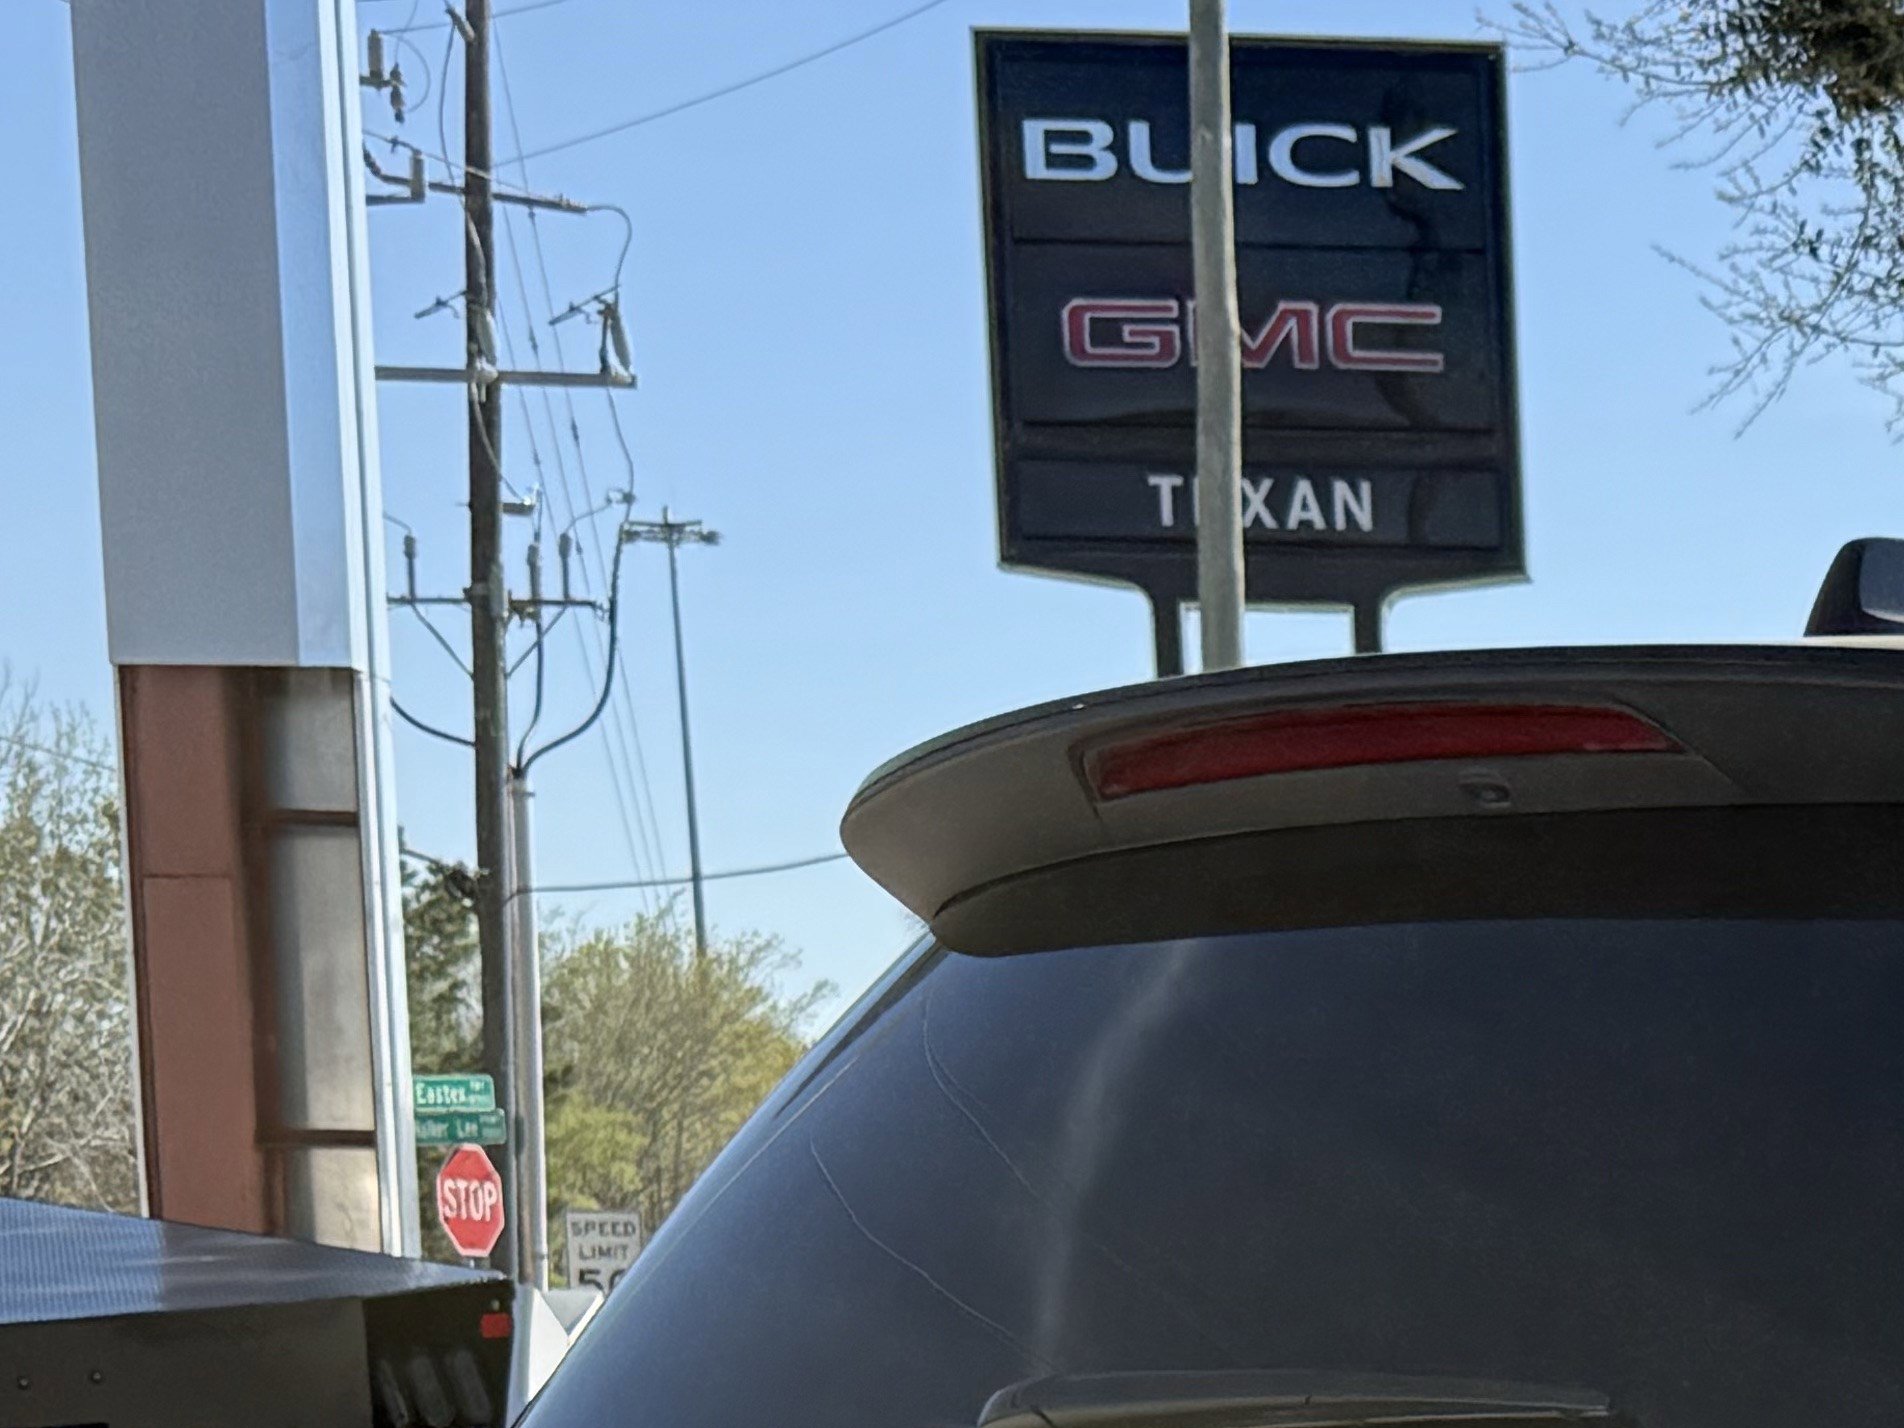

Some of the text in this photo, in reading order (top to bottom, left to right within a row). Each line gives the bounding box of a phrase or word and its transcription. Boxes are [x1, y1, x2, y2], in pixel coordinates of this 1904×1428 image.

[1022, 117, 1465, 191] BUICK
[1061, 297, 1445, 372] GMC
[1148, 474, 1373, 532] TXAN
[443, 1179, 497, 1222] STOP
[570, 1220, 636, 1237] SPEED
[579, 1244, 628, 1260] LIMIT
